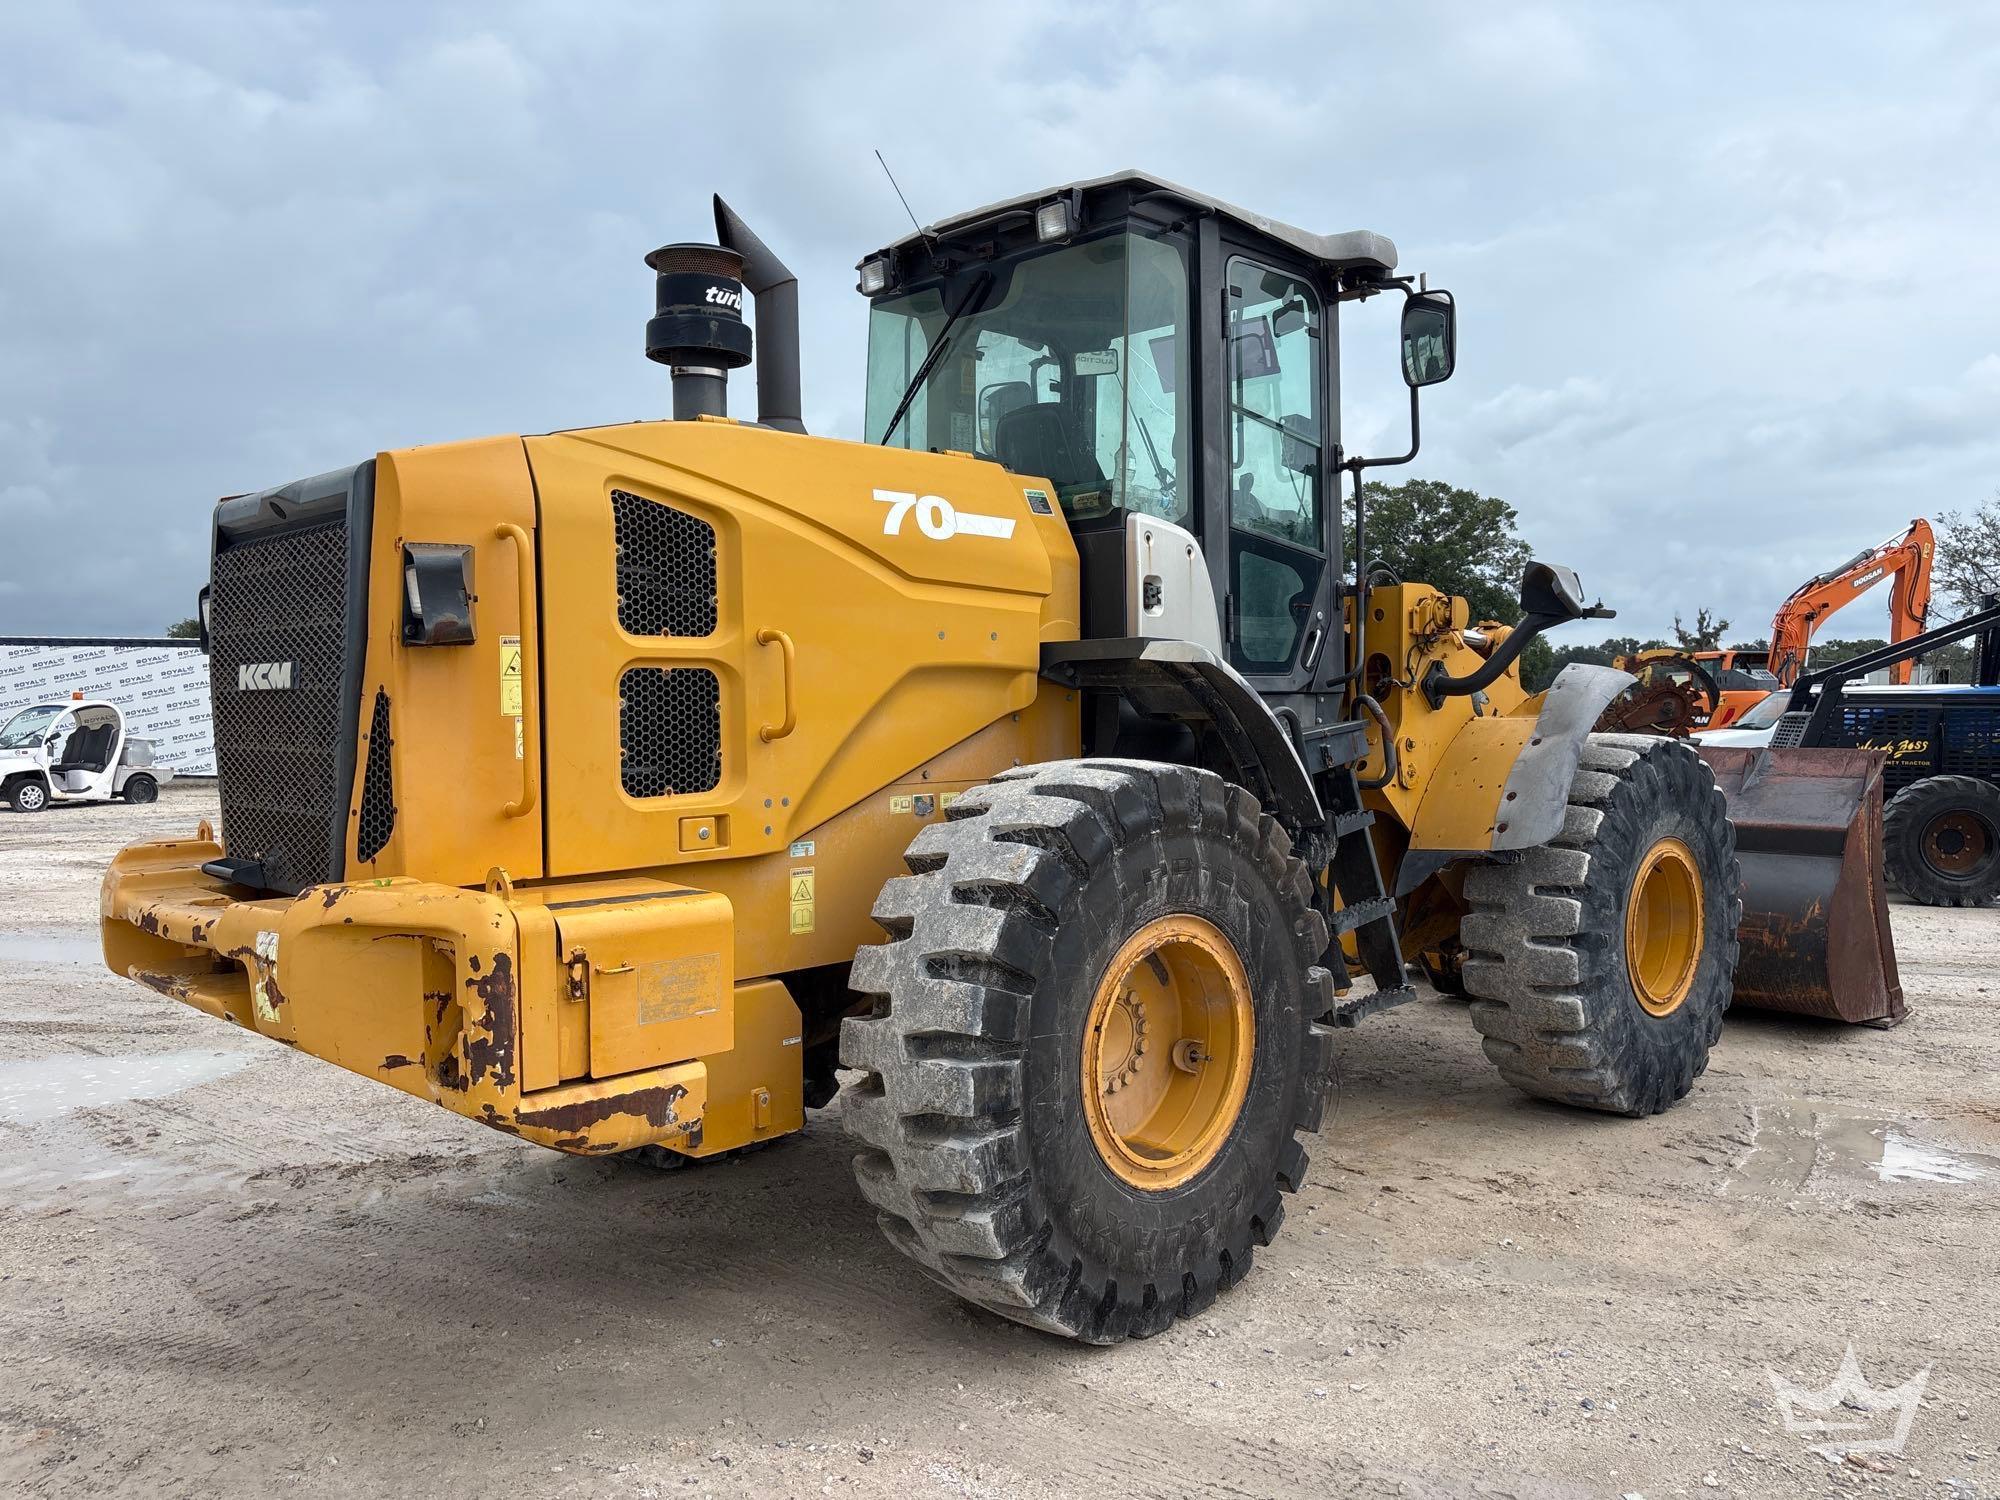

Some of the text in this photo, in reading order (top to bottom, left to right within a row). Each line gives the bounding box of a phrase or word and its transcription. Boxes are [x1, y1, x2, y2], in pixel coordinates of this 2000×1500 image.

[872, 488, 957, 540] 70
[1853, 567, 1883, 587] DOOSAN
[8, 647, 34, 656] ROYAL
[178, 649, 200, 657] ROYA
[72, 652, 97, 660] ROYAL
[136, 656, 162, 664] ROYAL
[32, 660, 58, 668] ROYAL
[95, 664, 122, 673] ROYAL
[161, 668, 187, 676] ROYAL
[54, 672, 78, 680] ROYAL
[239, 661, 292, 690] KCM
[14, 680, 39, 688] ROYAL
[120, 676, 145, 684] ROYAL
[79, 684, 104, 692] ROYAL
[142, 688, 167, 696] ROYAL
[38, 692, 63, 700] ROYAL
[167, 701, 193, 709] ROYAL
[148, 721, 174, 729] ROYAL
[173, 733, 199, 741] ROYAL
